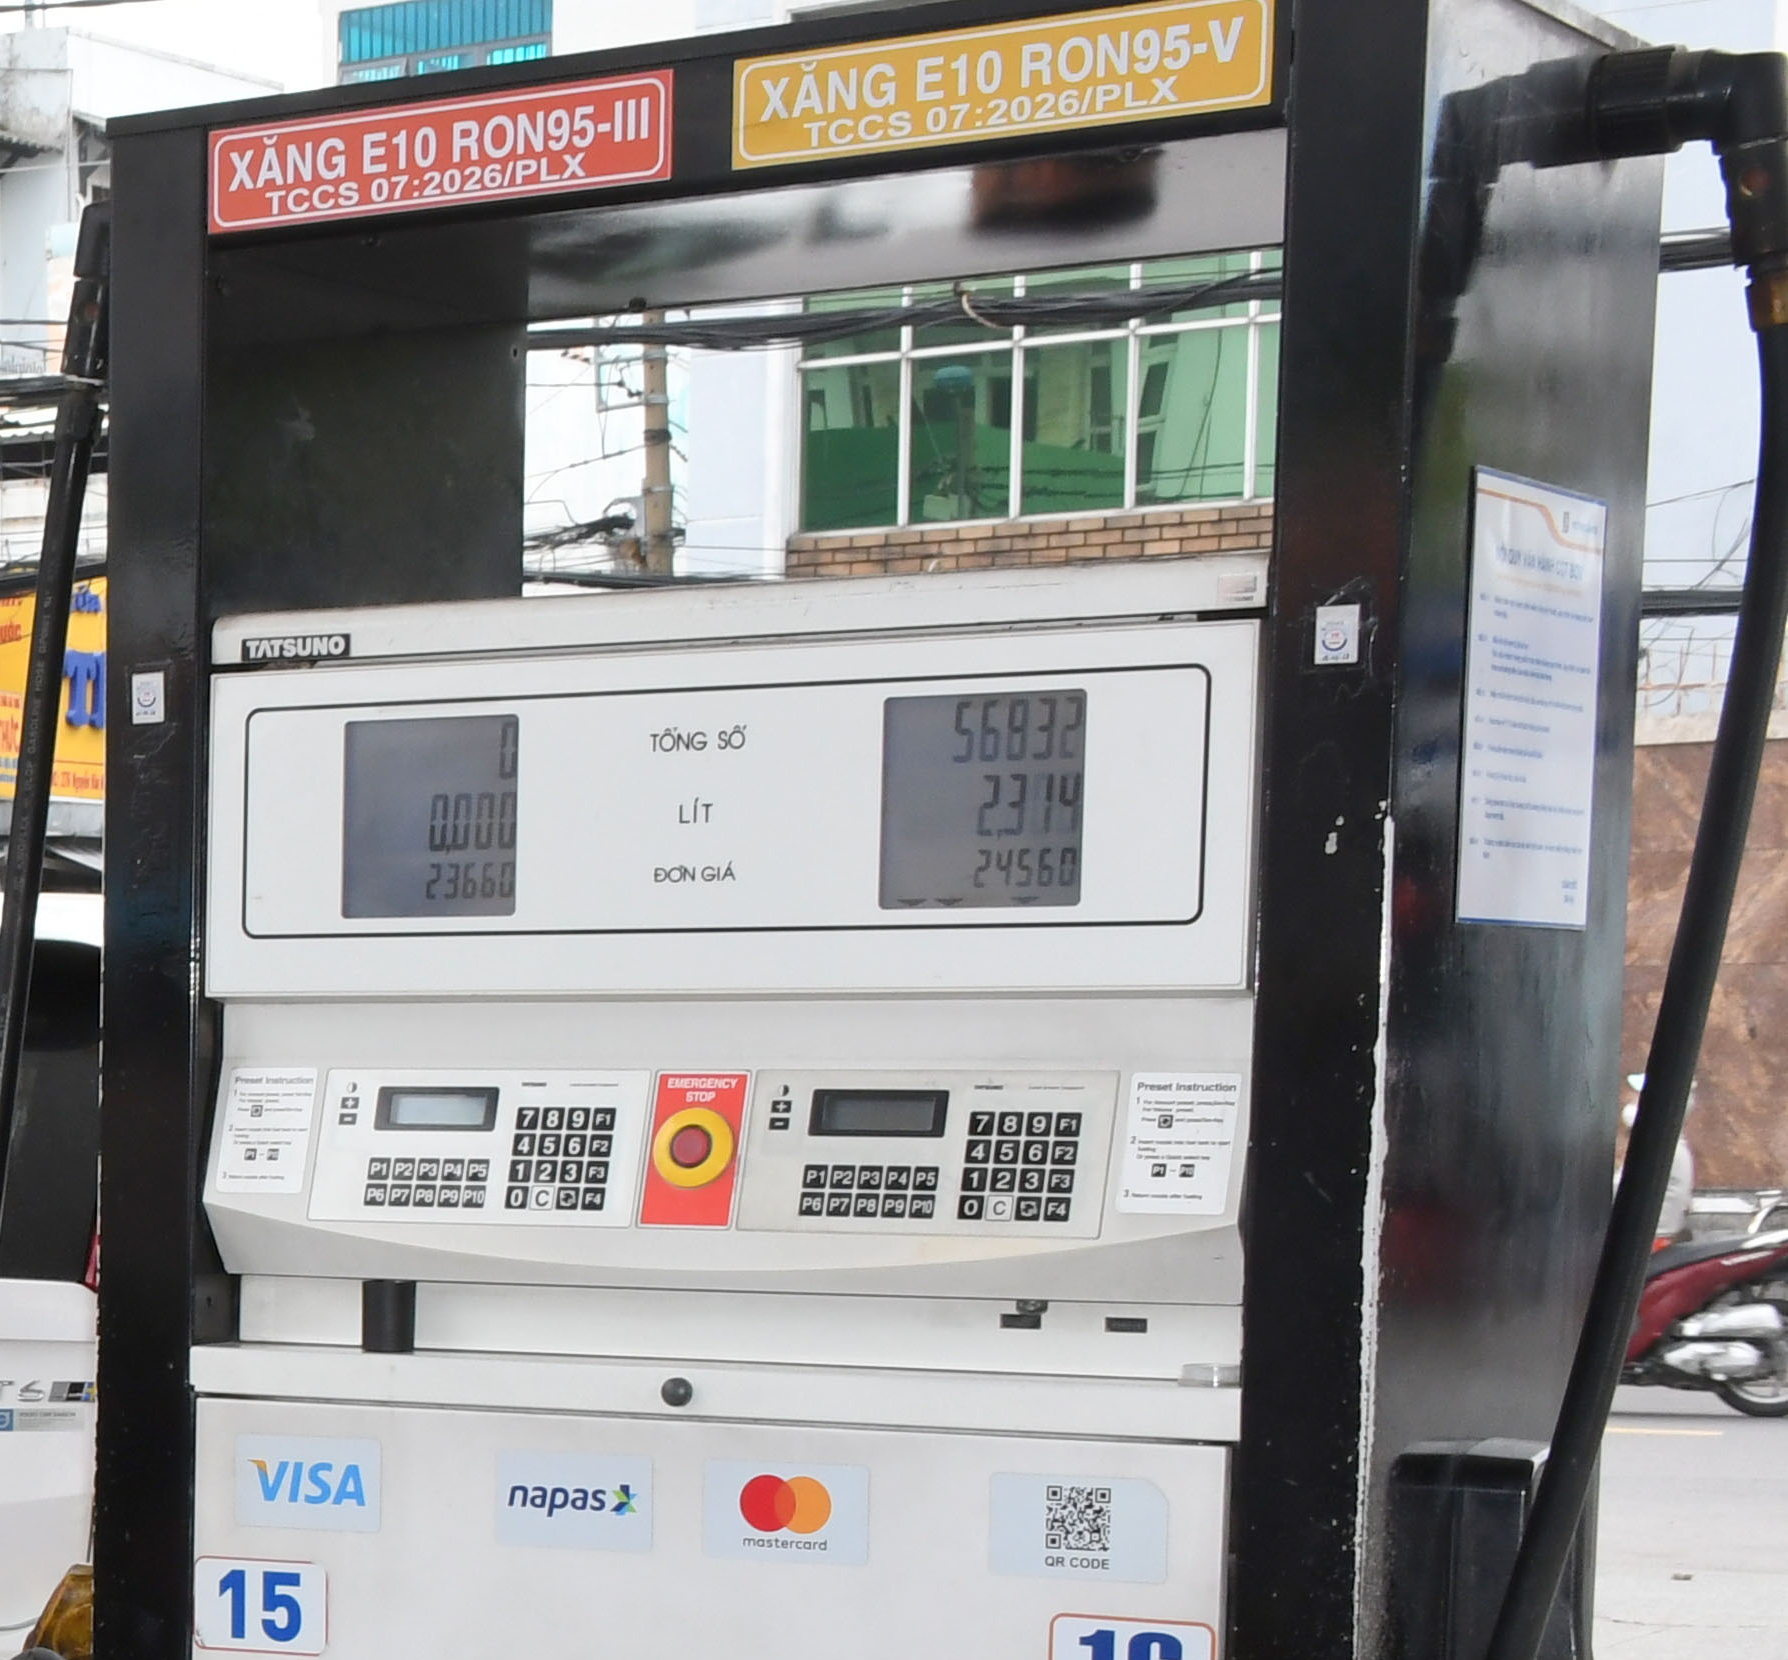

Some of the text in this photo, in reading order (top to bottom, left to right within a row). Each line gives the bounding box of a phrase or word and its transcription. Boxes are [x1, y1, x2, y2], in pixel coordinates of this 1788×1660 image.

[760, 16, 1244, 122] XĂNG E10 RON95-V
[804, 75, 1179, 148] TCCS 07:2026/PLX
[228, 96, 650, 192] XĂNG E10 RON95-III
[265, 151, 586, 217] TCCS 07:2026/PLX
[246, 634, 347, 660] TATSUNO
[649, 723, 749, 755] TỔNG SỐ
[953, 697, 1084, 763] 56832
[677, 799, 712, 824] LÍT
[426, 862, 516, 900] 23660
[653, 861, 736, 884] ĐƠN GIÁ
[974, 847, 1076, 888] 24560
[667, 1077, 739, 1091] EMERGENCY
[685, 1090, 716, 1103] STOP
[1136, 1082, 1237, 1092] Preset Instruction
[247, 1458, 367, 1508] VISA
[508, 1480, 609, 1517] napas
[741, 1535, 828, 1553] mastercard
[1043, 1555, 1110, 1571] QR CODE
[218, 1568, 304, 1643] 15
